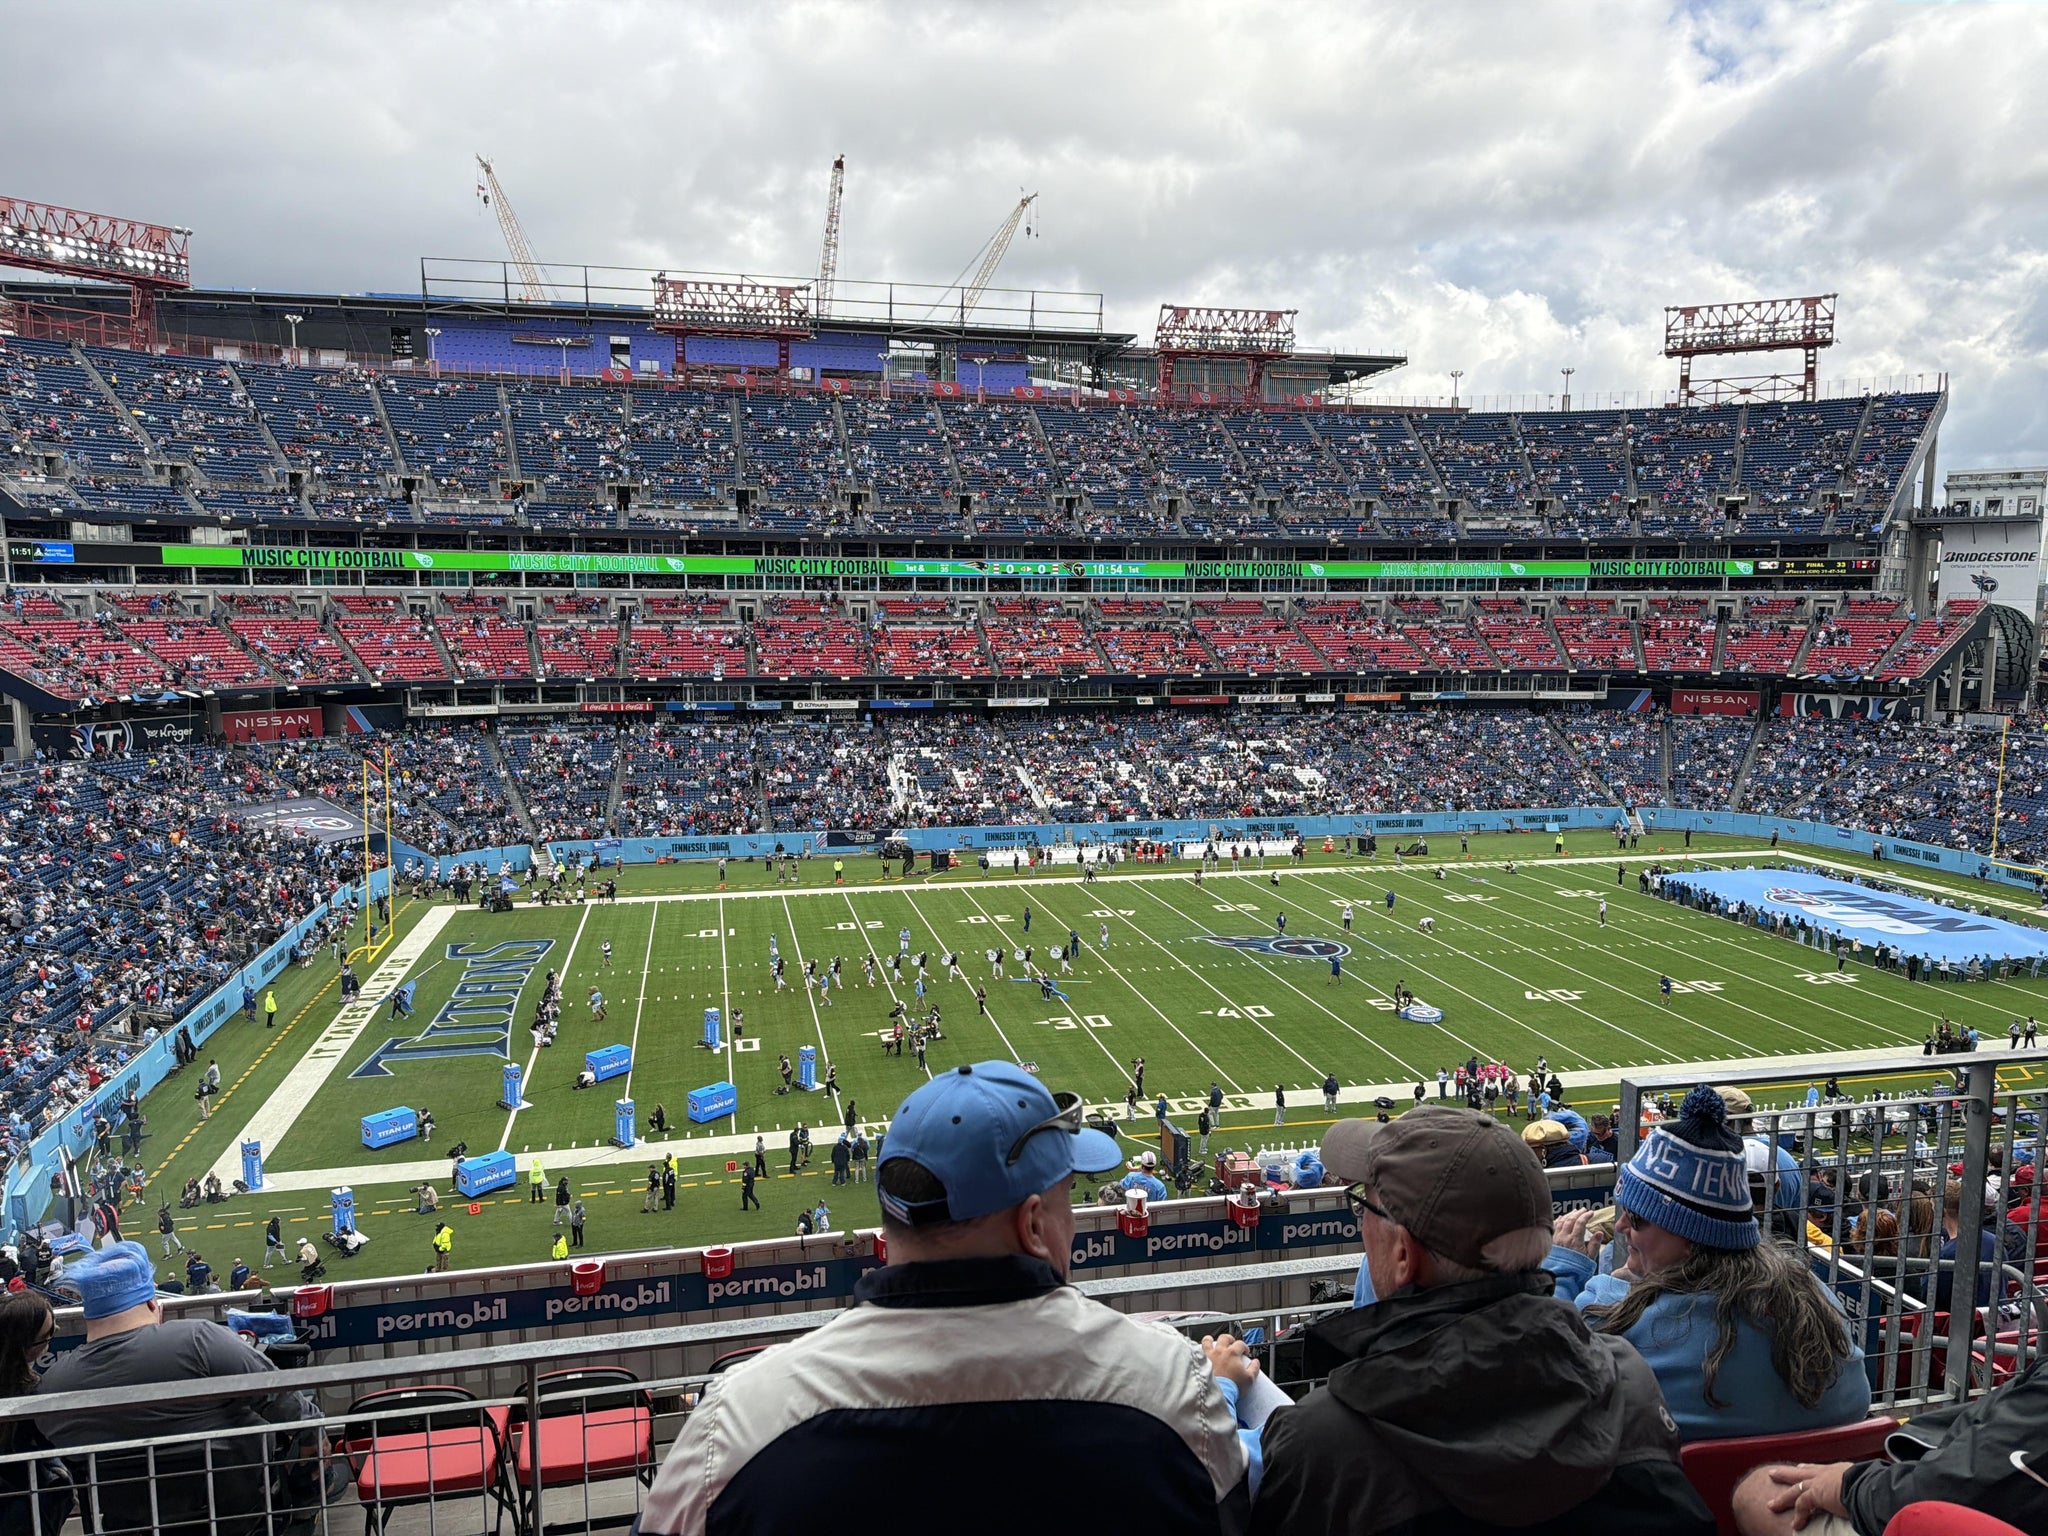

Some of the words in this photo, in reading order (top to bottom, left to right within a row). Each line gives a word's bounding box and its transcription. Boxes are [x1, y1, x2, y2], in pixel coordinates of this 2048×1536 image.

[11, 547, 31, 556] 11:51
[242, 549, 293, 566] MUSIC
[298, 550, 331, 567] CITY
[335, 551, 405, 568] FOOTBALL
[1943, 552, 2038, 562] BRIDGESTONE
[509, 553, 557, 570] MUSIC
[559, 555, 591, 571] CITY
[594, 555, 658, 572] FOOTBALL
[754, 559, 796, 574] MUSIC
[800, 559, 828, 574] CITY
[831, 560, 889, 574] FOOTBALL
[905, 564, 917, 572] 1st
[918, 564, 925, 572] &
[1006, 565, 1014, 574] 0
[1038, 565, 1046, 574] 0
[1092, 564, 1123, 575] 10:54
[1128, 566, 1139, 574] 1st
[1381, 562, 1417, 576] MUSIC
[1420, 562, 1445, 576] CITY
[1448, 562, 1502, 576] FOOTBALL
[1590, 562, 1630, 576] MUSIC
[1634, 562, 1662, 575] CITY
[1665, 561, 1727, 575] FOOTBALL
[1185, 563, 1221, 577] MUSIC
[1224, 563, 1249, 577] CITY
[1251, 563, 1303, 577] FOOTBALL
[1683, 694, 1749, 705] NISSAN
[235, 714, 310, 729] NISSAN
[160, 724, 193, 742] Kroger
[1376, 820, 1404, 828] TENNESSEE
[1406, 819, 1423, 828] TOUGH
[1523, 815, 1550, 823] TENNESSEE
[1551, 814, 1569, 823] TOUGH
[1113, 828, 1143, 836] TENNESSEE
[1247, 823, 1275, 832] TENNESSEE
[334, 836, 369, 846] NISSA
[855, 834, 876, 842] CATCH
[985, 832, 1016, 841] TENNESSEE
[671, 843, 706, 853] TENNESSEE
[708, 842, 729, 851] TOUGH
[1893, 844, 1921, 859] TENNESSEE
[1922, 851, 1940, 863] TOUGH
[1443, 894, 1490, 902] 30
[1554, 889, 1601, 898] 20
[1092, 909, 1136, 918] 40
[1212, 903, 1260, 913] 50
[1804, 889, 1999, 932] TITAN
[836, 920, 885, 930] 20
[967, 915, 1015, 924] 30
[1801, 906, 1930, 935] UP
[699, 928, 735, 938] 10
[386, 957, 413, 970] US
[378, 969, 402, 985] OF
[1793, 972, 1860, 985] 20
[359, 983, 388, 1001] ALL
[1525, 988, 1582, 1002] 40
[347, 939, 556, 1079] TITANS
[1216, 1005, 1275, 1019] 40
[194, 1008, 214, 1037] TENNESSEE
[214, 997, 226, 1019] TOUGH
[324, 1004, 373, 1042] TAKES
[1048, 1014, 1113, 1030] 30
[308, 1036, 342, 1060] IT
[600, 1061, 619, 1072] TITAN
[619, 1058, 629, 1066] UP
[98, 1087, 124, 1119] ENNESSEE
[703, 1102, 722, 1113] TITAN
[723, 1098, 734, 1107] UP
[1096, 1096, 1256, 1118] CANCR
[378, 1126, 401, 1138] TITAN
[401, 1123, 414, 1132] UP
[727, 1162, 736, 1171] 10
[474, 1173, 500, 1186] TITAN
[500, 1169, 512, 1179] UP
[470, 1203, 479, 1213] G
[1148, 1225, 1250, 1256] permobil
[1071, 1235, 1115, 1264] obil
[708, 1267, 827, 1304] permobil
[546, 1281, 670, 1320] permobil
[377, 1298, 507, 1338] permobil
